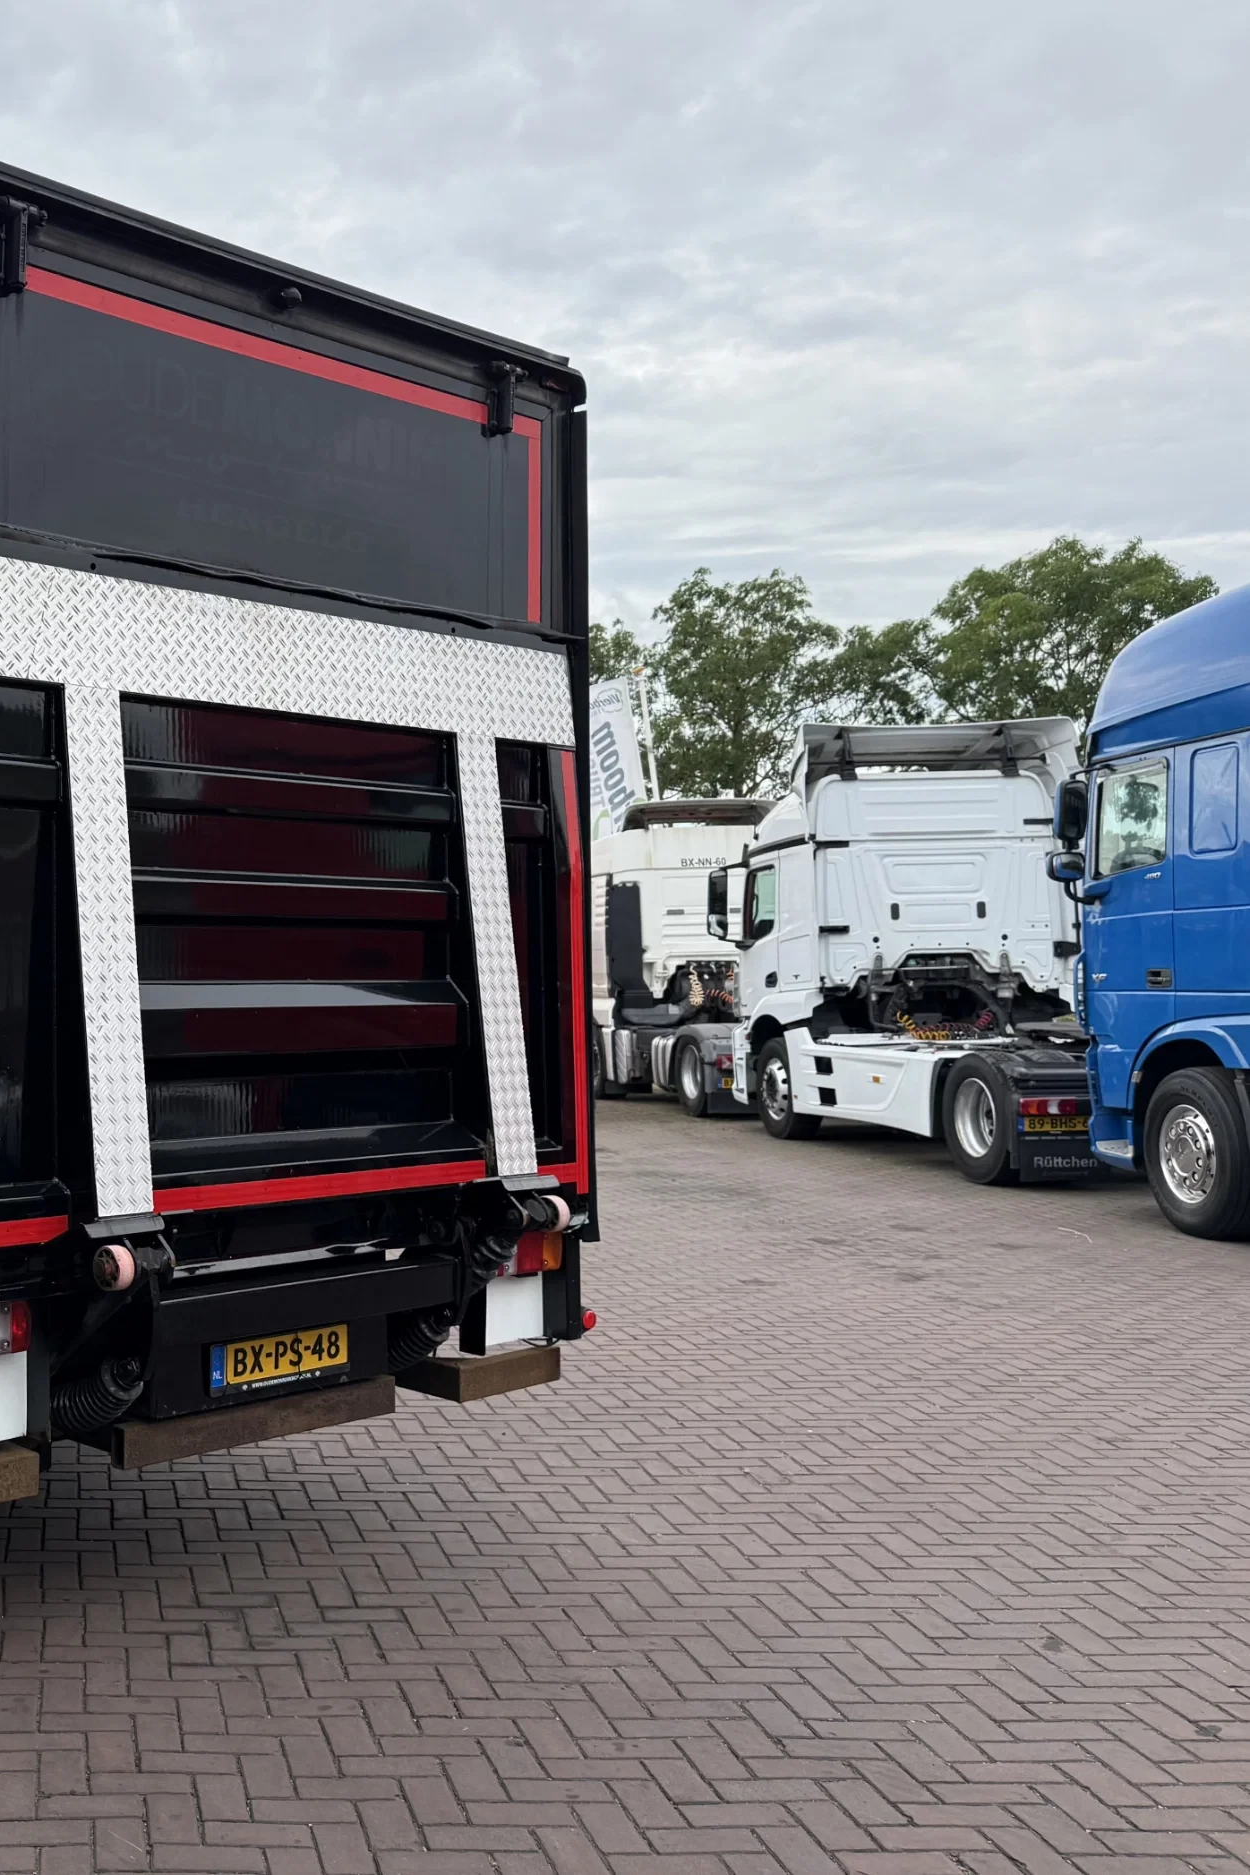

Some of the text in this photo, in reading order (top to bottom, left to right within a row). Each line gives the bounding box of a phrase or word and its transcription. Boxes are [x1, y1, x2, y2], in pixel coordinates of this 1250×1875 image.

[680, 857, 727, 868] BX-NN-60
[1033, 1155, 1098, 1168] Rüttchen
[233, 1331, 340, 1378] BX-PS-48
[212, 1370, 222, 1381] NL
